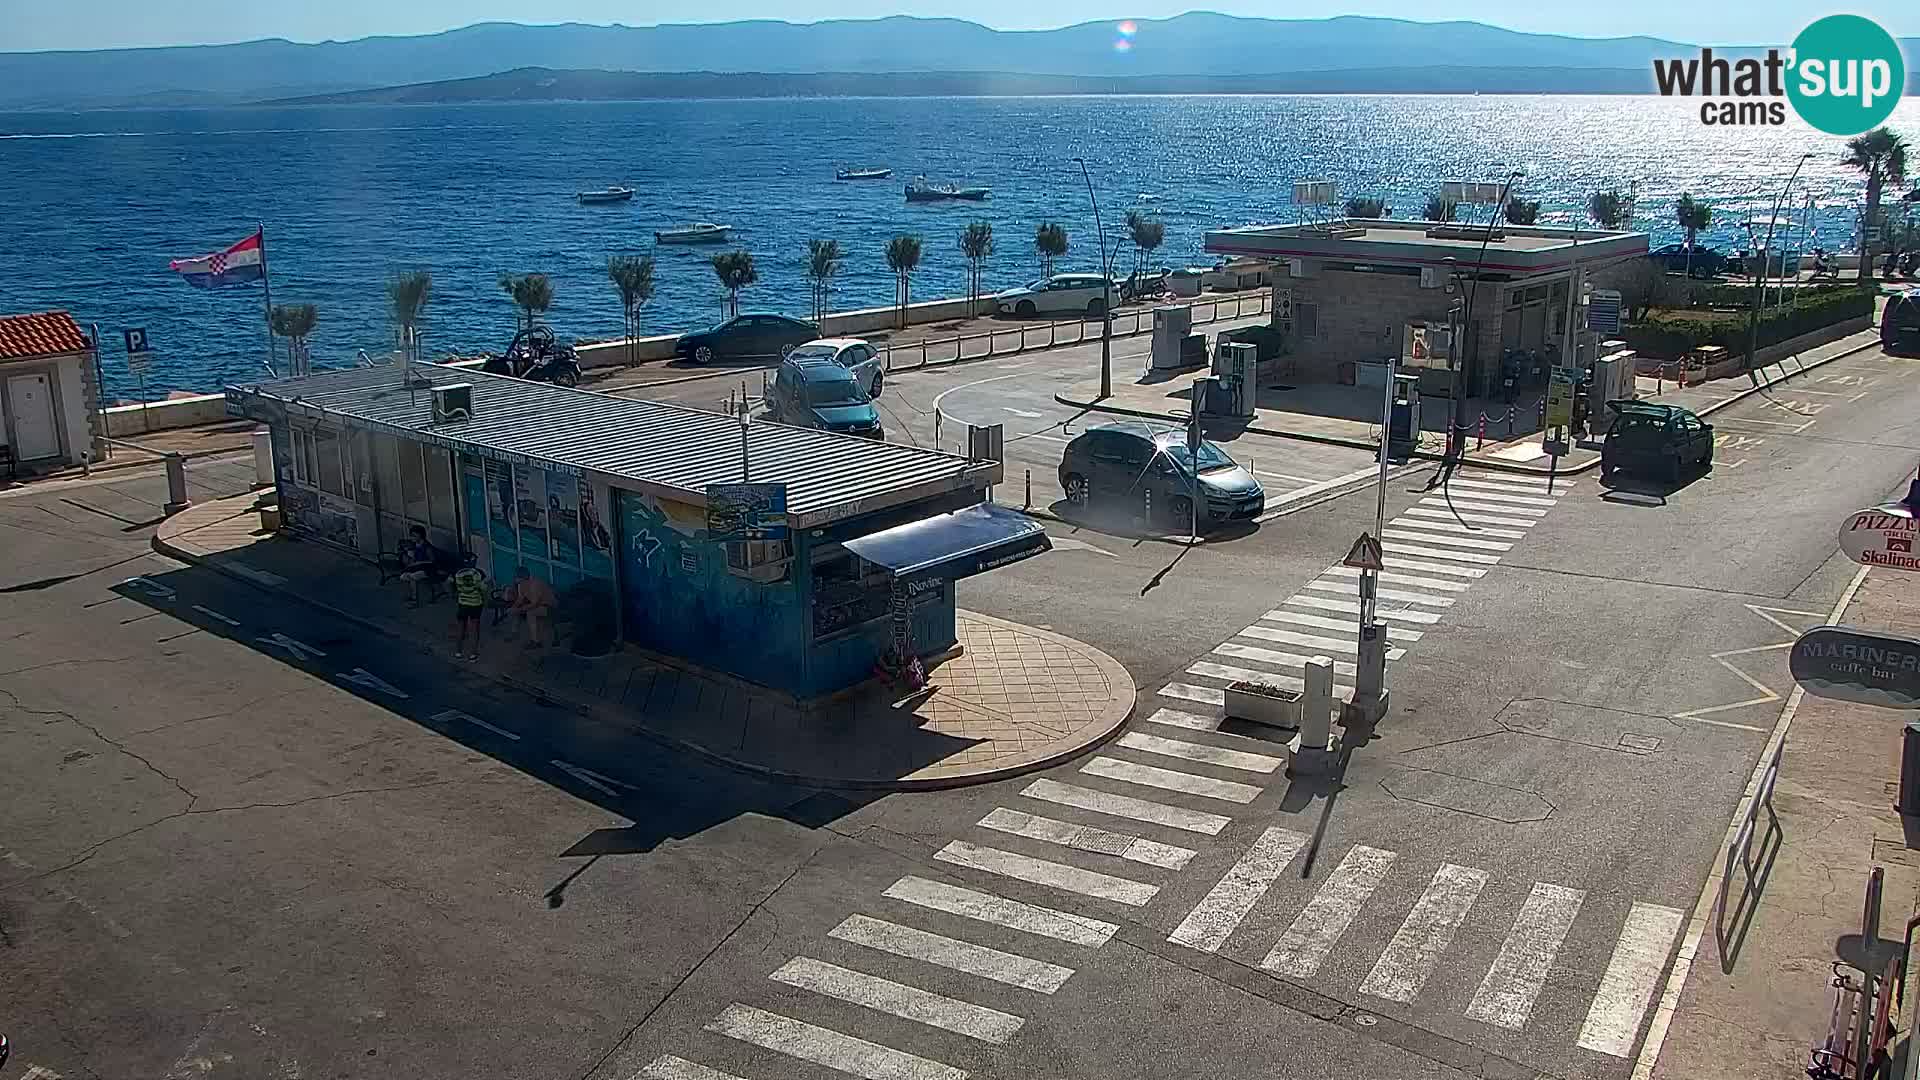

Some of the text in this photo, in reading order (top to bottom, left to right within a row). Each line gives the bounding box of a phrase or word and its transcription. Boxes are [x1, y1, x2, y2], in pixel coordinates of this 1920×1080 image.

[130, 331, 141, 350] P
[1759, 398, 1828, 415] TAXI
[494, 449, 526, 465] STATION
[529, 457, 554, 472] TICKET
[555, 463, 583, 478] OFFICE
[1850, 515, 1920, 531] PIZZE
[1803, 642, 1920, 673] MARINER
[1873, 666, 1897, 680] bar
